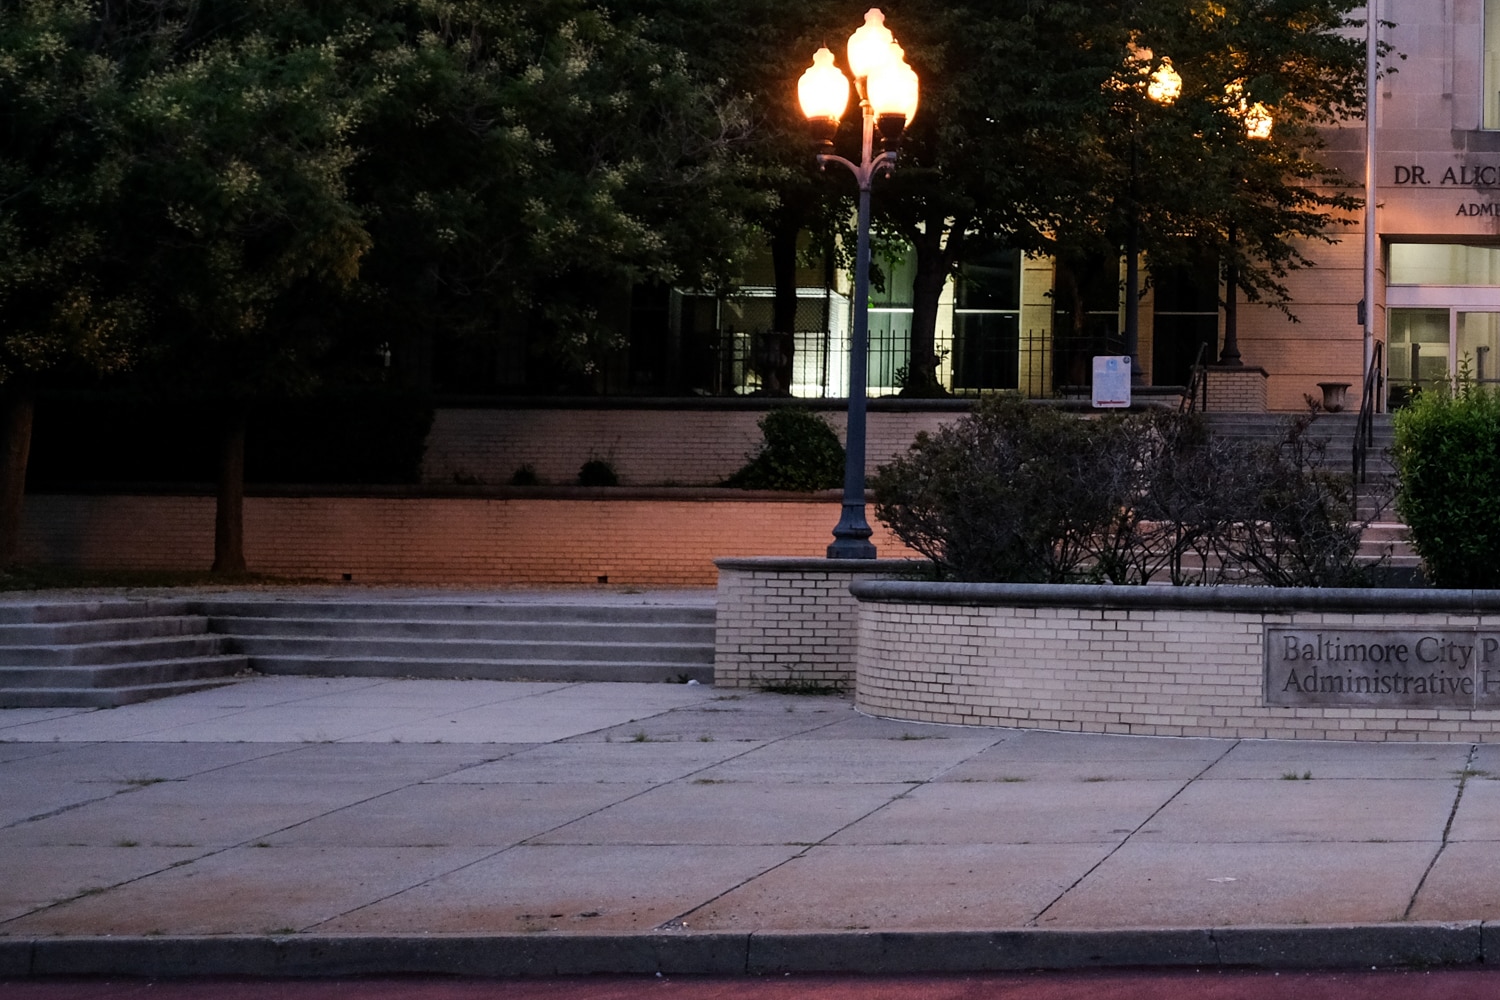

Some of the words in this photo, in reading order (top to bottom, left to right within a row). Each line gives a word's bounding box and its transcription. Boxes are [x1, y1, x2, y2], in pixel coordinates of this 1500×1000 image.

[1394, 165, 1431, 185] DR.
[1282, 634, 1409, 663] Baltimore
[1415, 636, 1474, 670] City
[1281, 666, 1474, 695] Administrative
